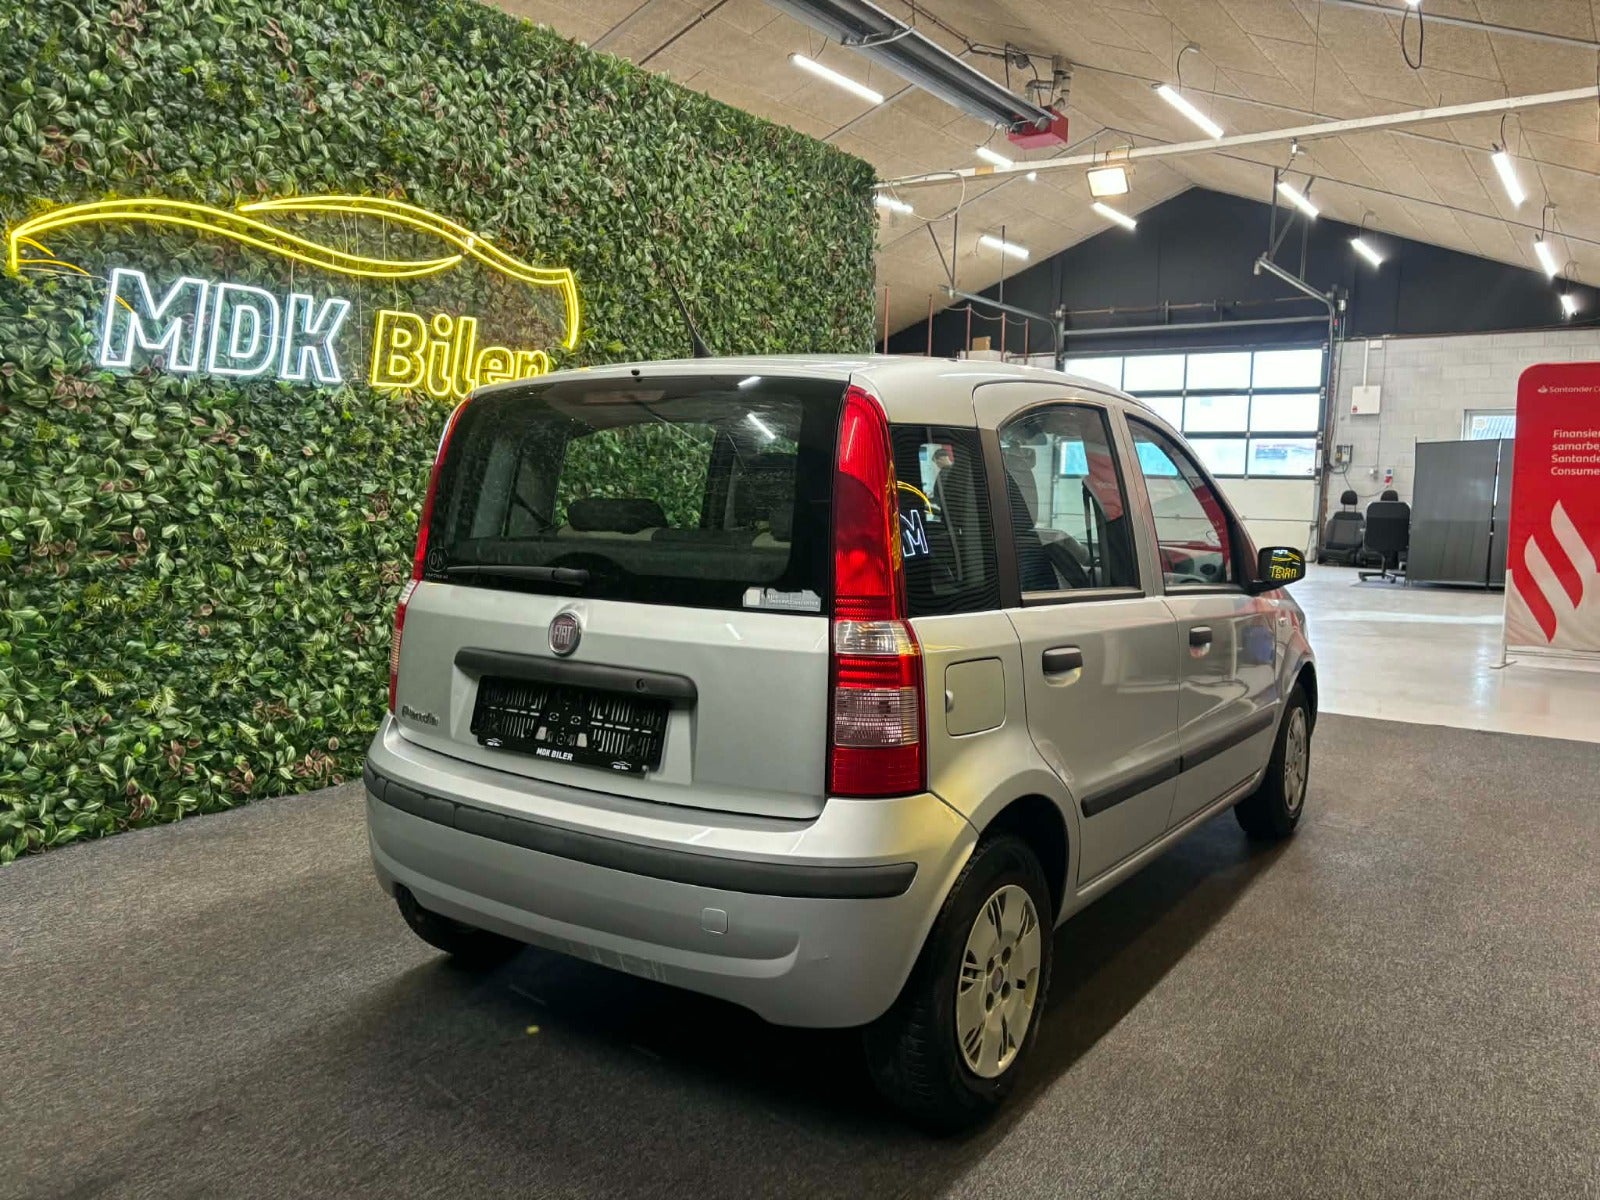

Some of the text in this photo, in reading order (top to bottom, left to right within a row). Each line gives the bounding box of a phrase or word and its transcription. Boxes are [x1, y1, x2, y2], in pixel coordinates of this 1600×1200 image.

[100, 267, 351, 384] MDK
[1549, 385, 1592, 393] Santander
[1552, 442, 1600, 452] samarbe
[553, 624, 574, 645] FIAT
[551, 750, 574, 761] BILER
